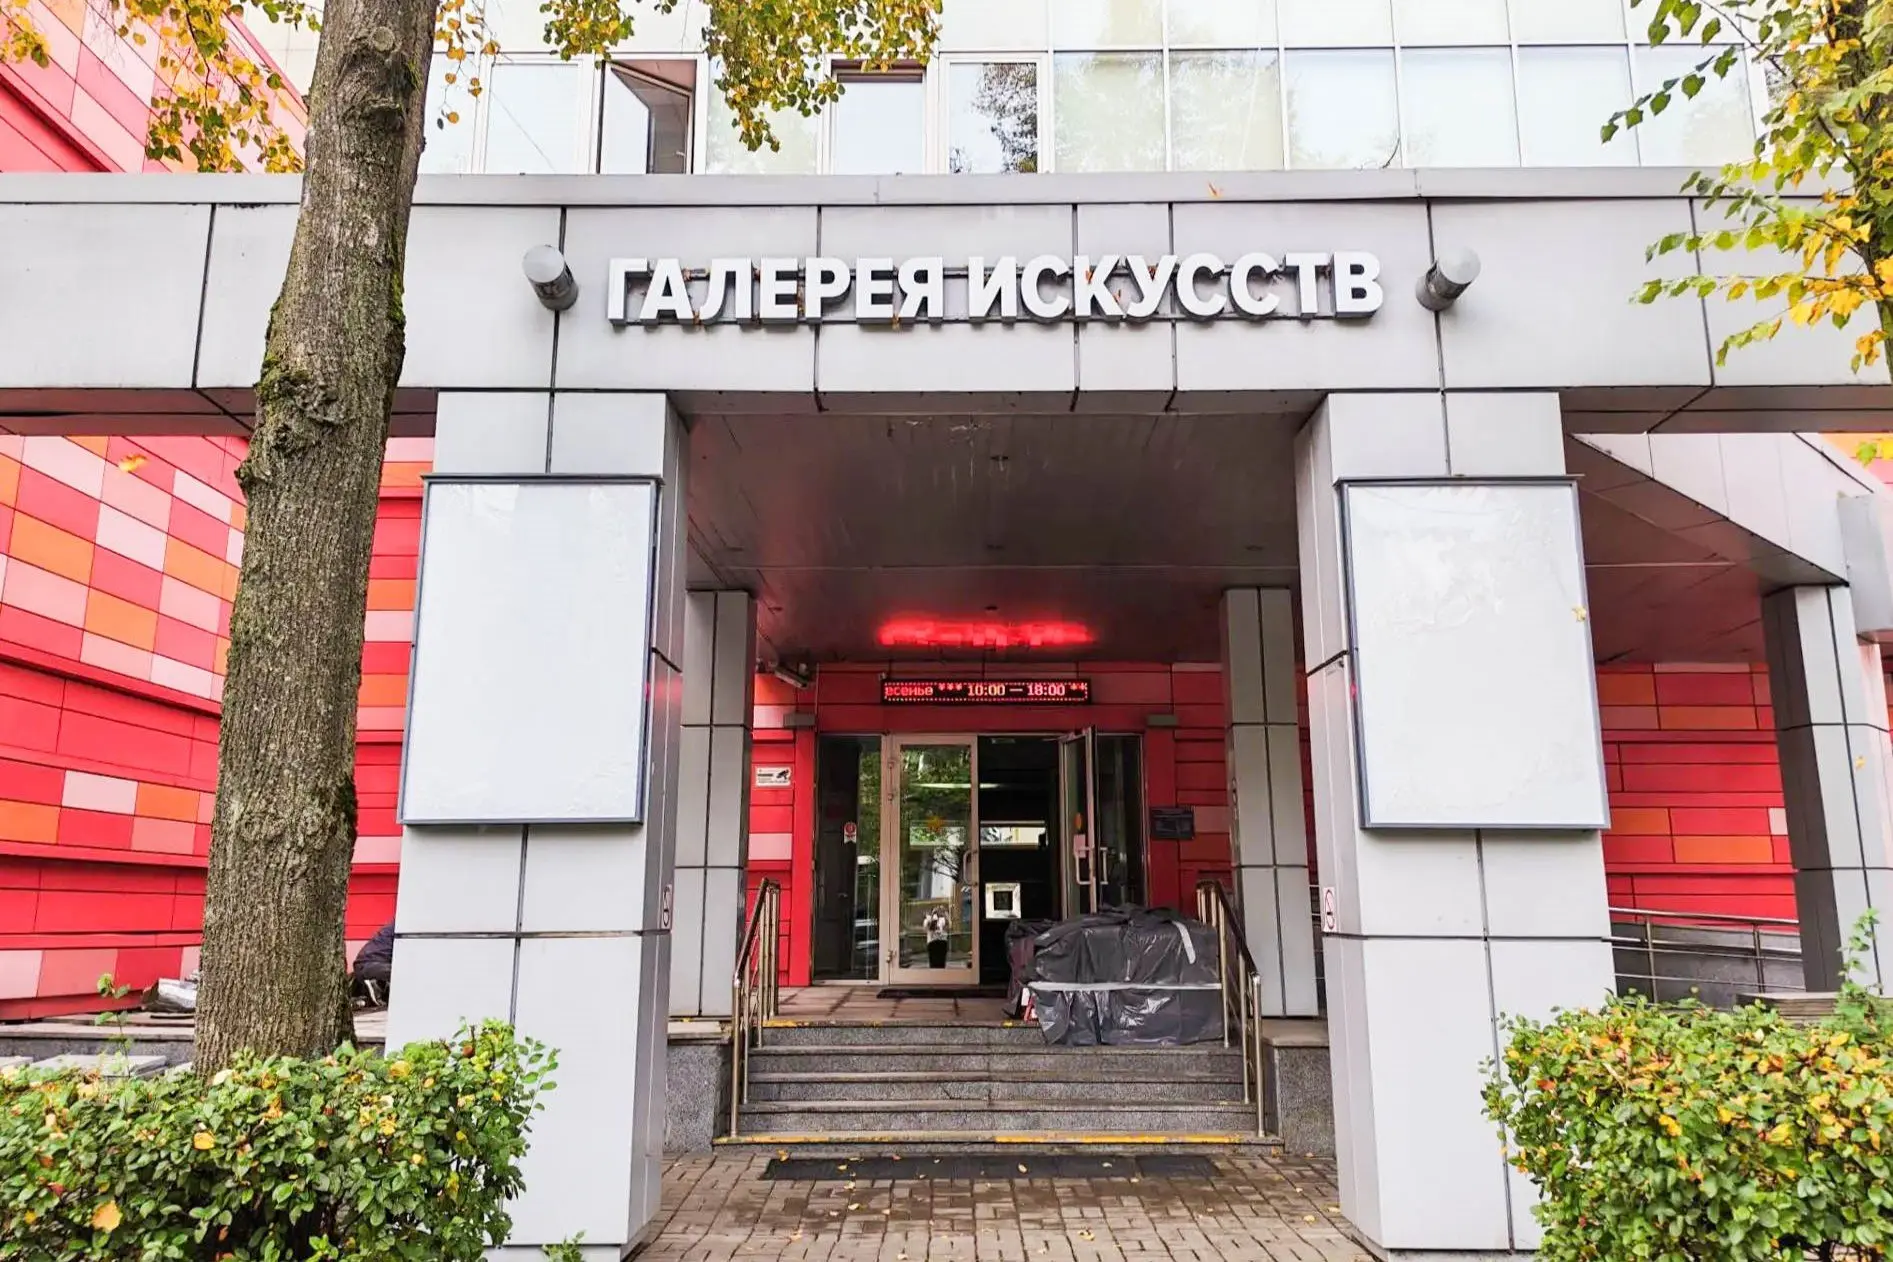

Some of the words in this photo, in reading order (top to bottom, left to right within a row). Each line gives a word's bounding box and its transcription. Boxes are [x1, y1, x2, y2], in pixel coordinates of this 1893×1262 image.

[607, 256, 943, 321] ГАЛЕРЕЯ
[968, 251, 1384, 320] ИСКУССТВ
[967, 683, 1006, 697] 10:00
[1027, 683, 1066, 697] 18:00
